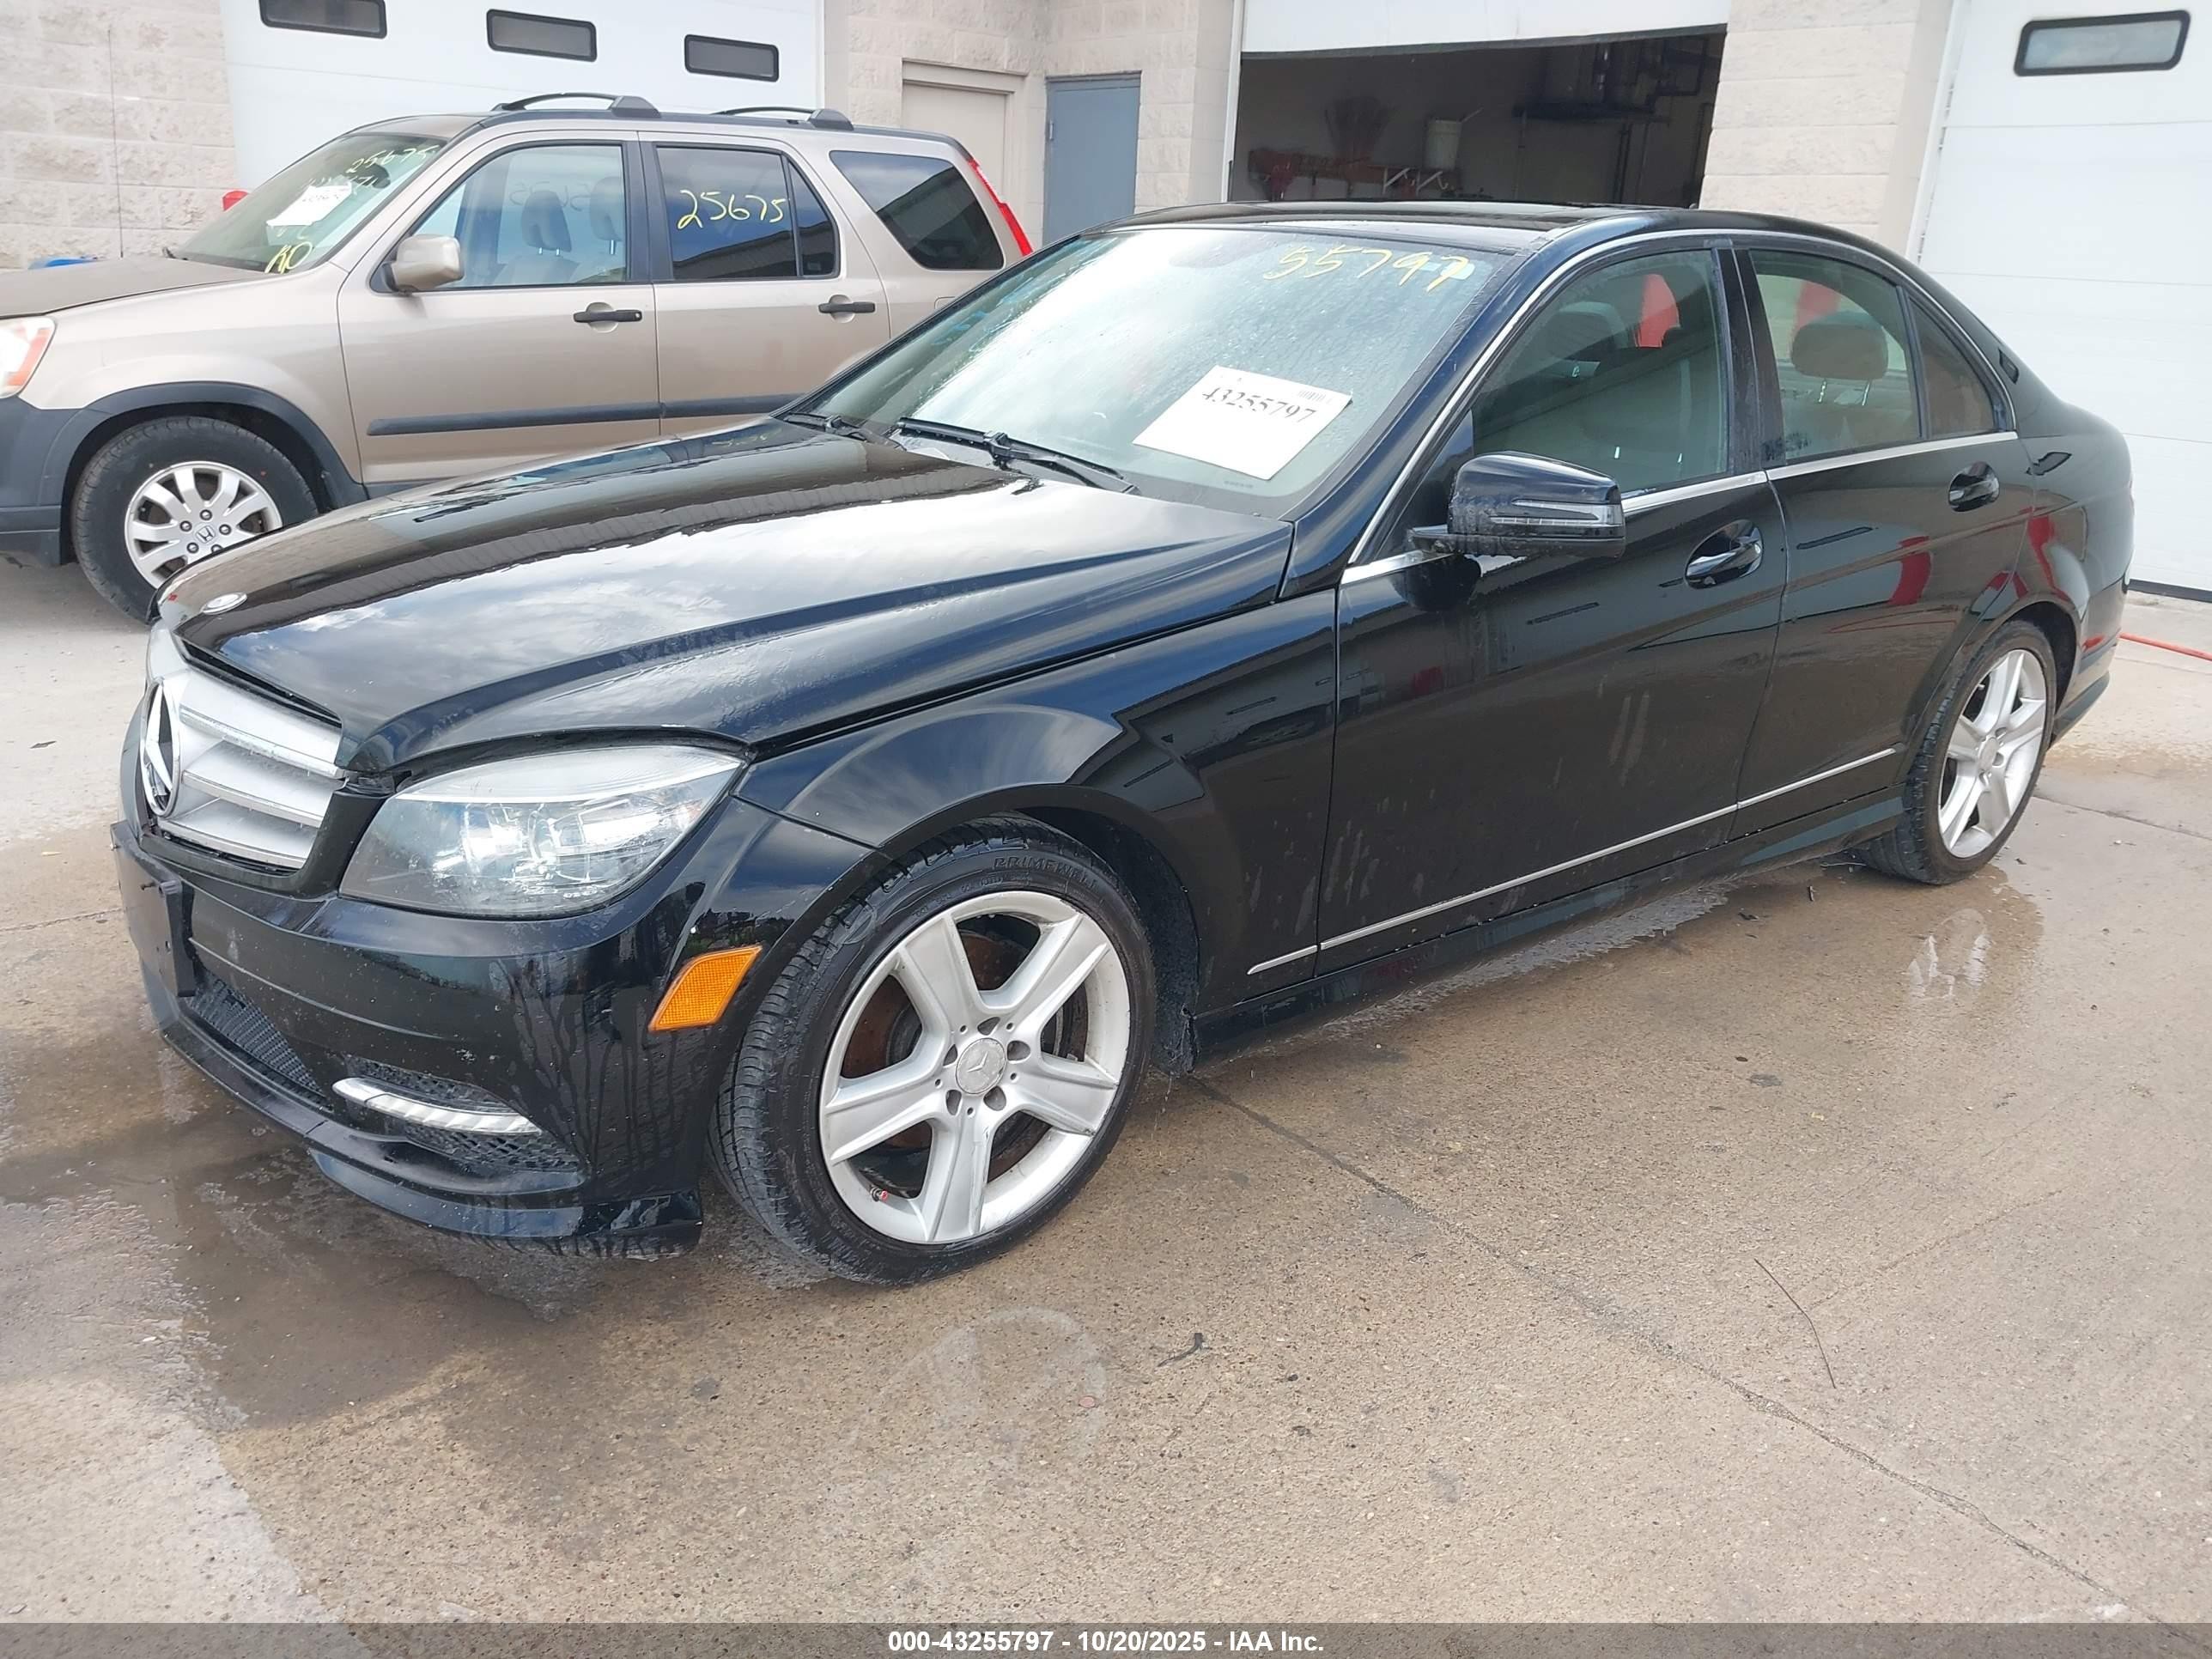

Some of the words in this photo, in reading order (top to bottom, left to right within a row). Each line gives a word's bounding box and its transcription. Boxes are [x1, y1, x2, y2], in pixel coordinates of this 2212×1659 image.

[345, 144, 441, 174] 25675
[677, 189, 787, 230] 25675
[1262, 244, 1469, 293] 55797
[1201, 386, 1317, 423] 43255797
